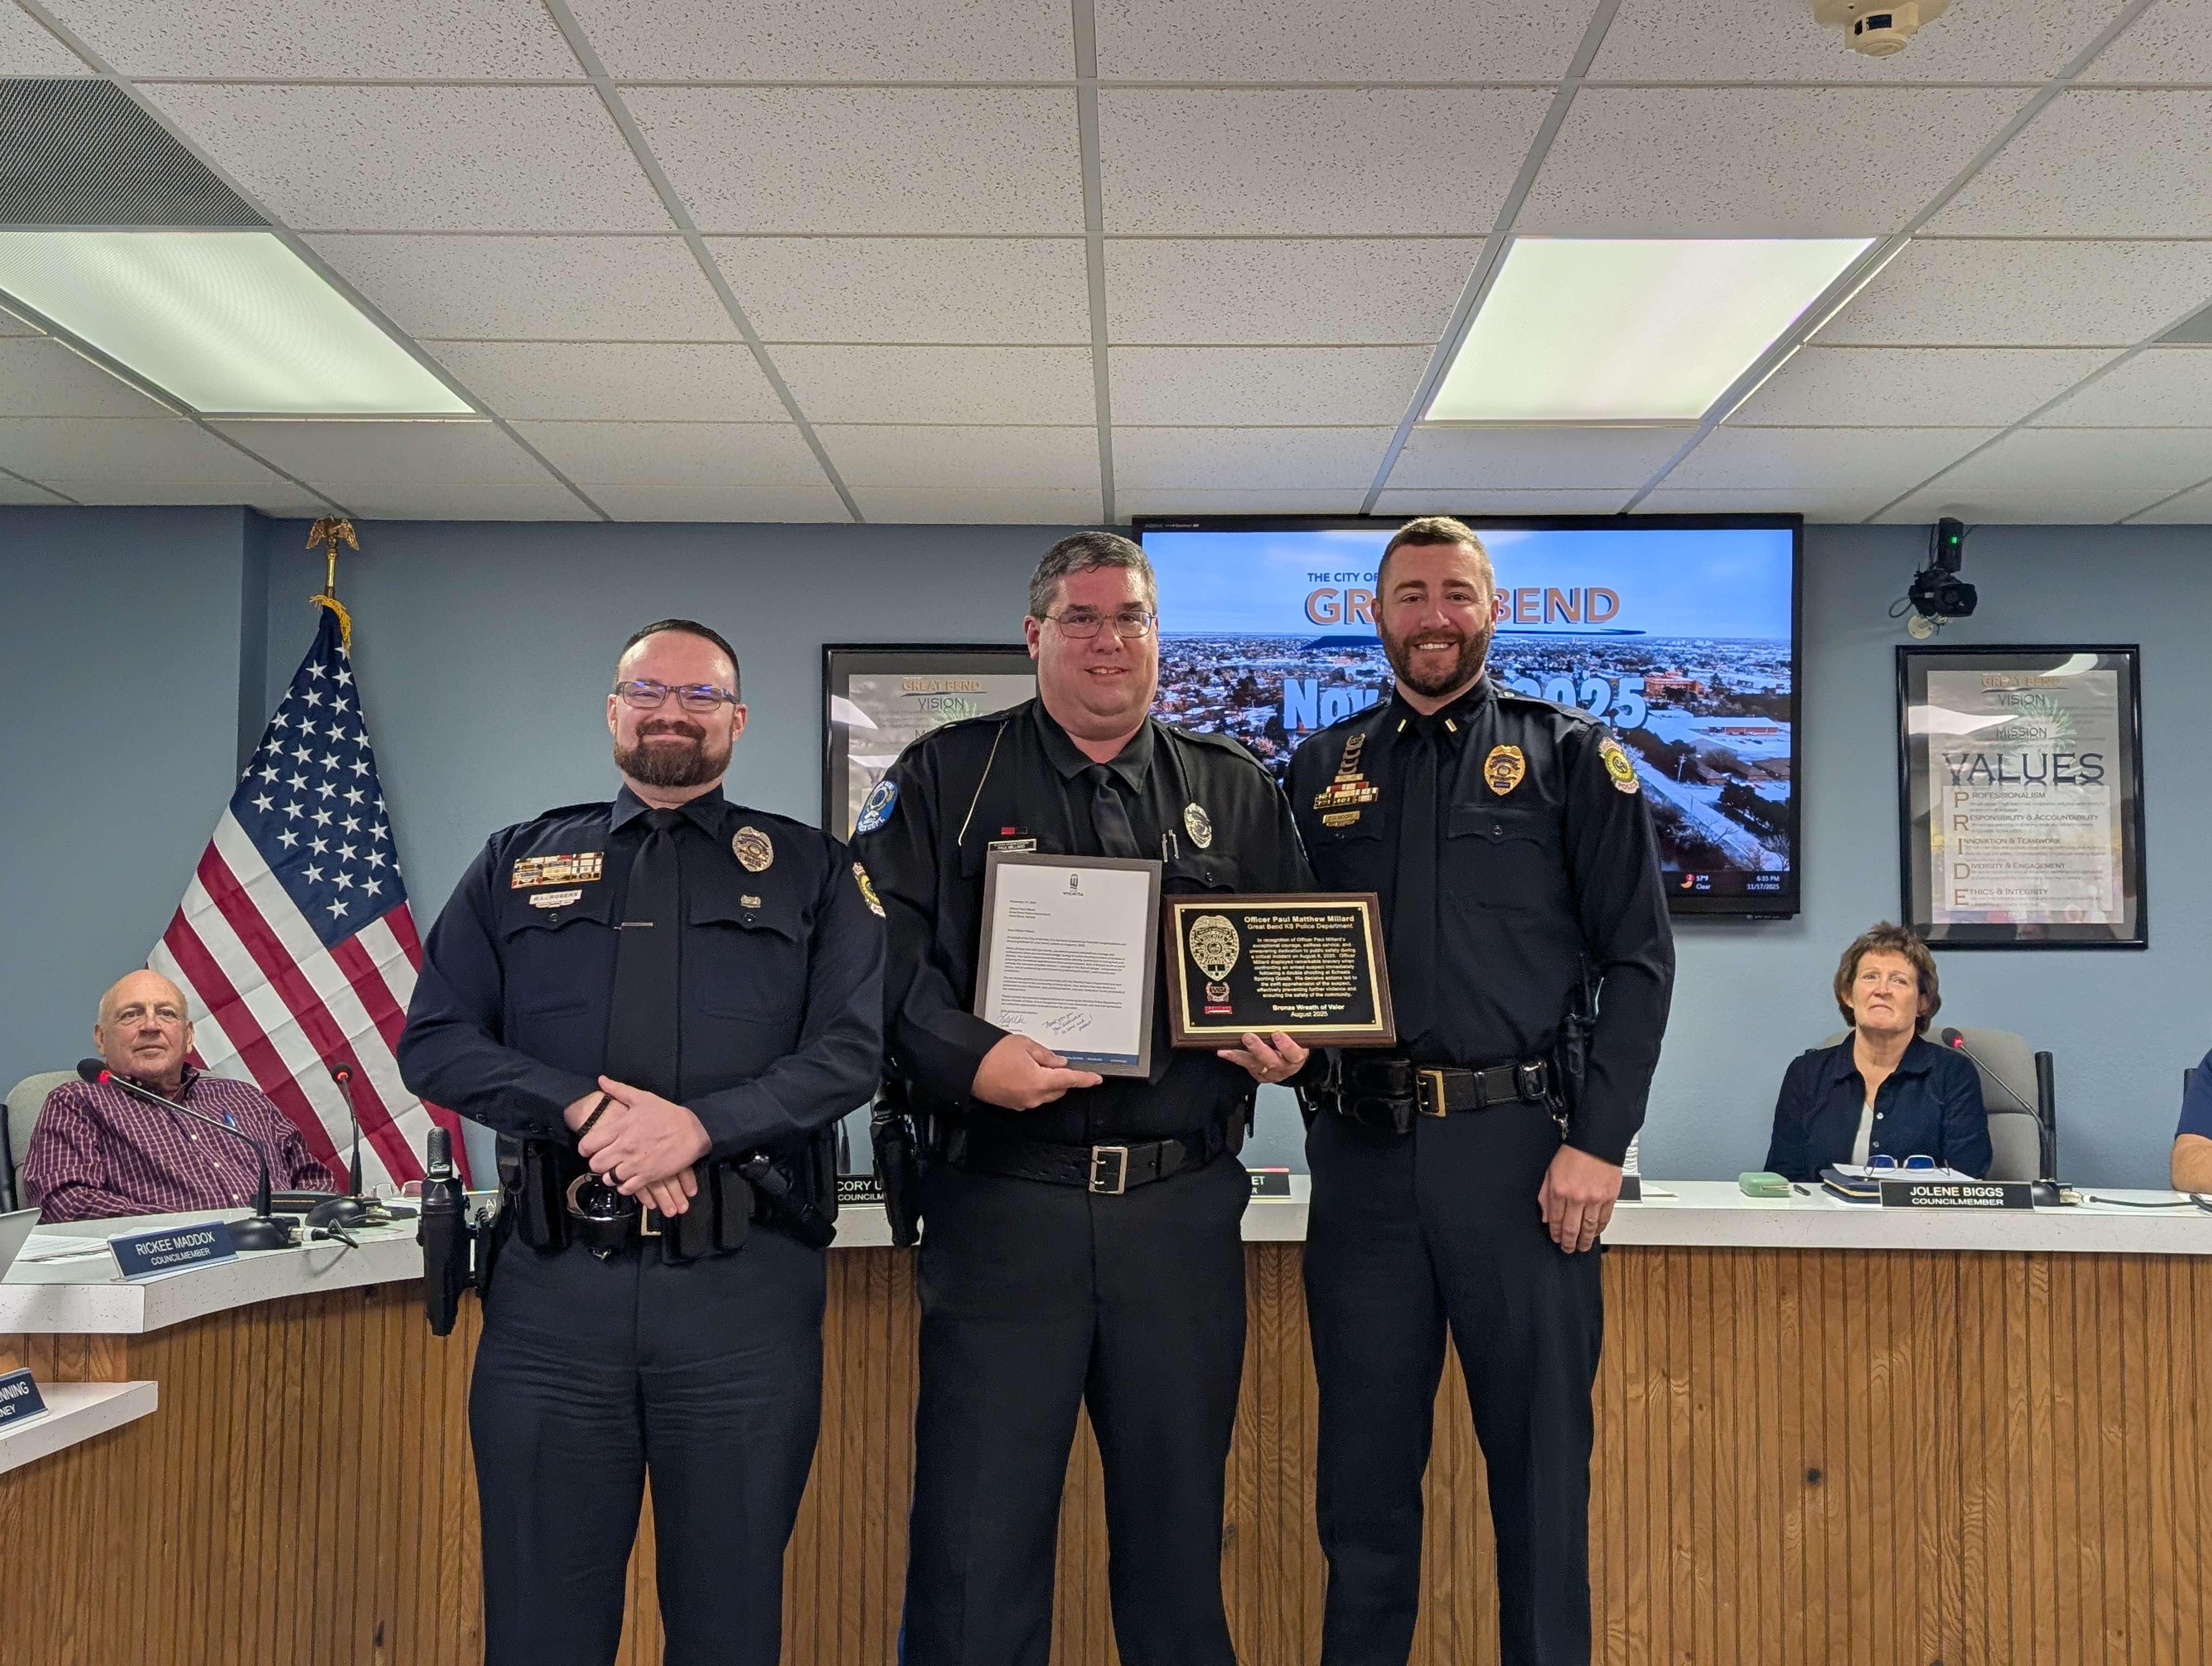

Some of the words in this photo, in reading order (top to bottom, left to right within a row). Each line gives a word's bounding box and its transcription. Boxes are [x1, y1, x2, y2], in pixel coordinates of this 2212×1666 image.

[1307, 573, 1330, 582] THE
[1334, 573, 1360, 582] CITY
[902, 680, 941, 691] GREAT
[945, 680, 982, 691] BEND
[918, 697, 964, 707] VISION
[1998, 694, 2046, 704] VISION
[1996, 727, 2047, 738] MISSION
[1942, 753, 2104, 783] VALUES
[837, 1180, 872, 1191] CORY
[838, 1193, 885, 1201] COUNCILM
[1909, 1186, 1960, 1196] JOLENE
[1963, 1187, 2004, 1197] BIGGS
[1912, 1197, 2004, 1206] COUNCILMEMBER
[135, 1238, 173, 1256] RICKEE
[173, 1231, 216, 1249] MADDOX
[151, 1247, 211, 1266] COUNCILMEMBER
